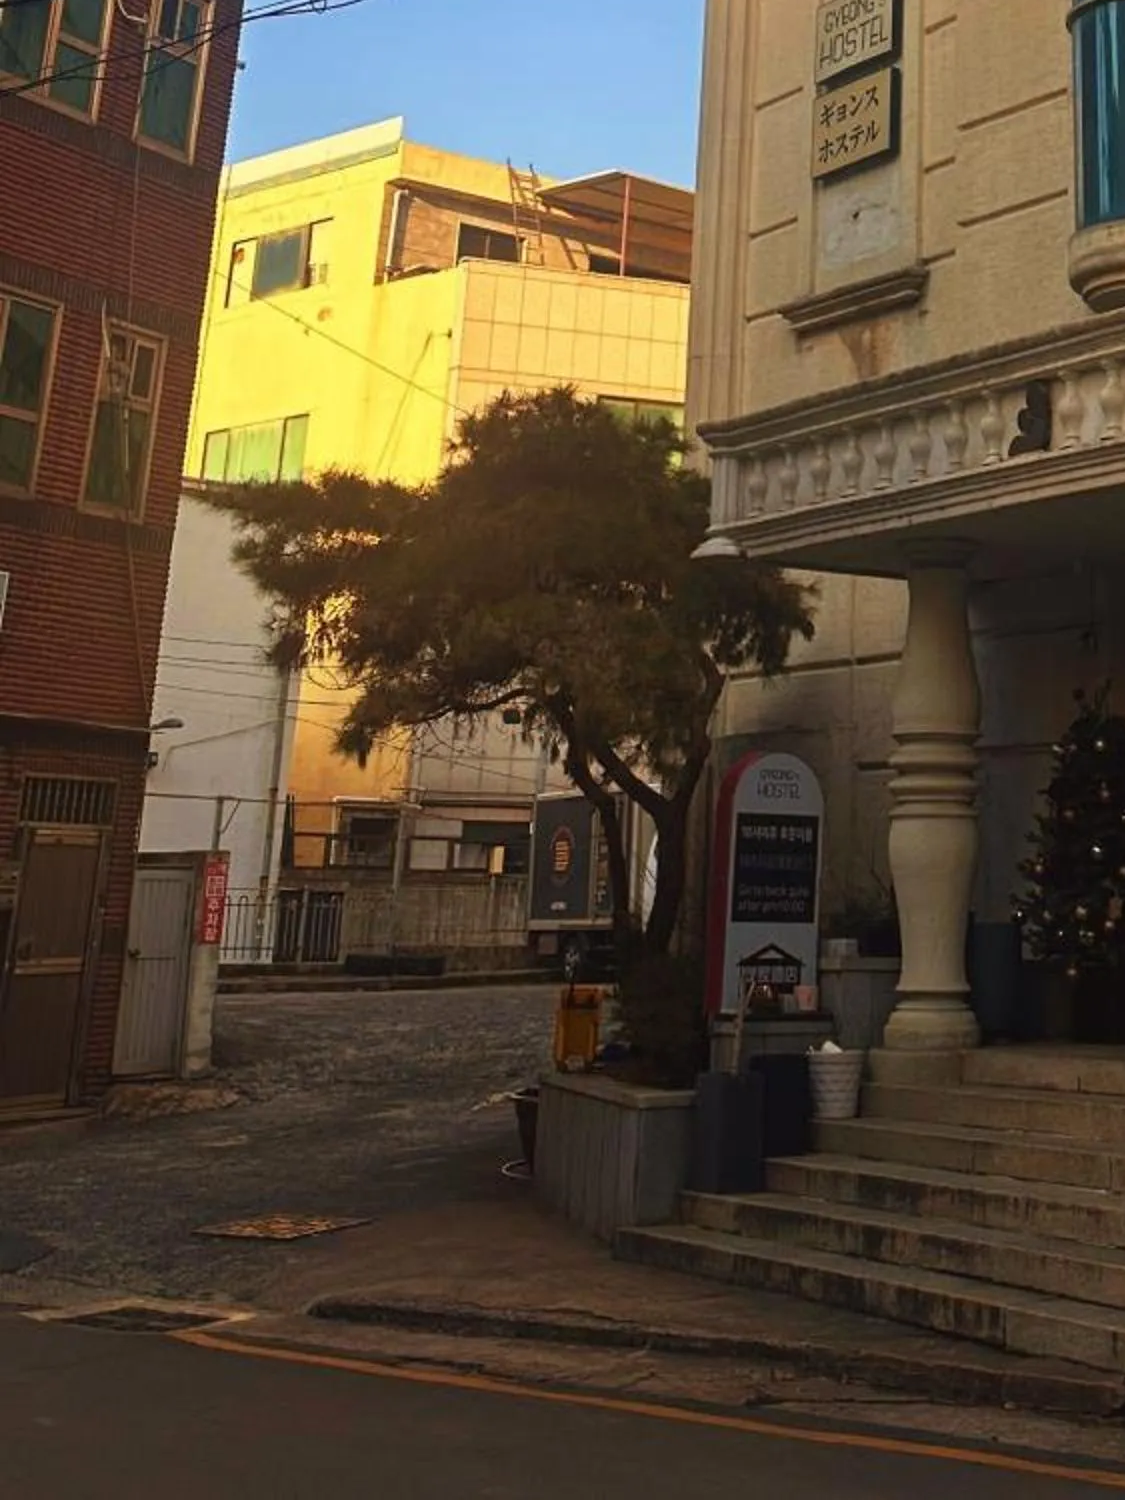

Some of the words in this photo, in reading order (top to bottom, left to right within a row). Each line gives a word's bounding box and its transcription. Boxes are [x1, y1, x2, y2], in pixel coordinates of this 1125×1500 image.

[819, 14, 889, 70] HOSTEL
[819, 86, 880, 128] ギョンス
[818, 118, 880, 163] ホステル
